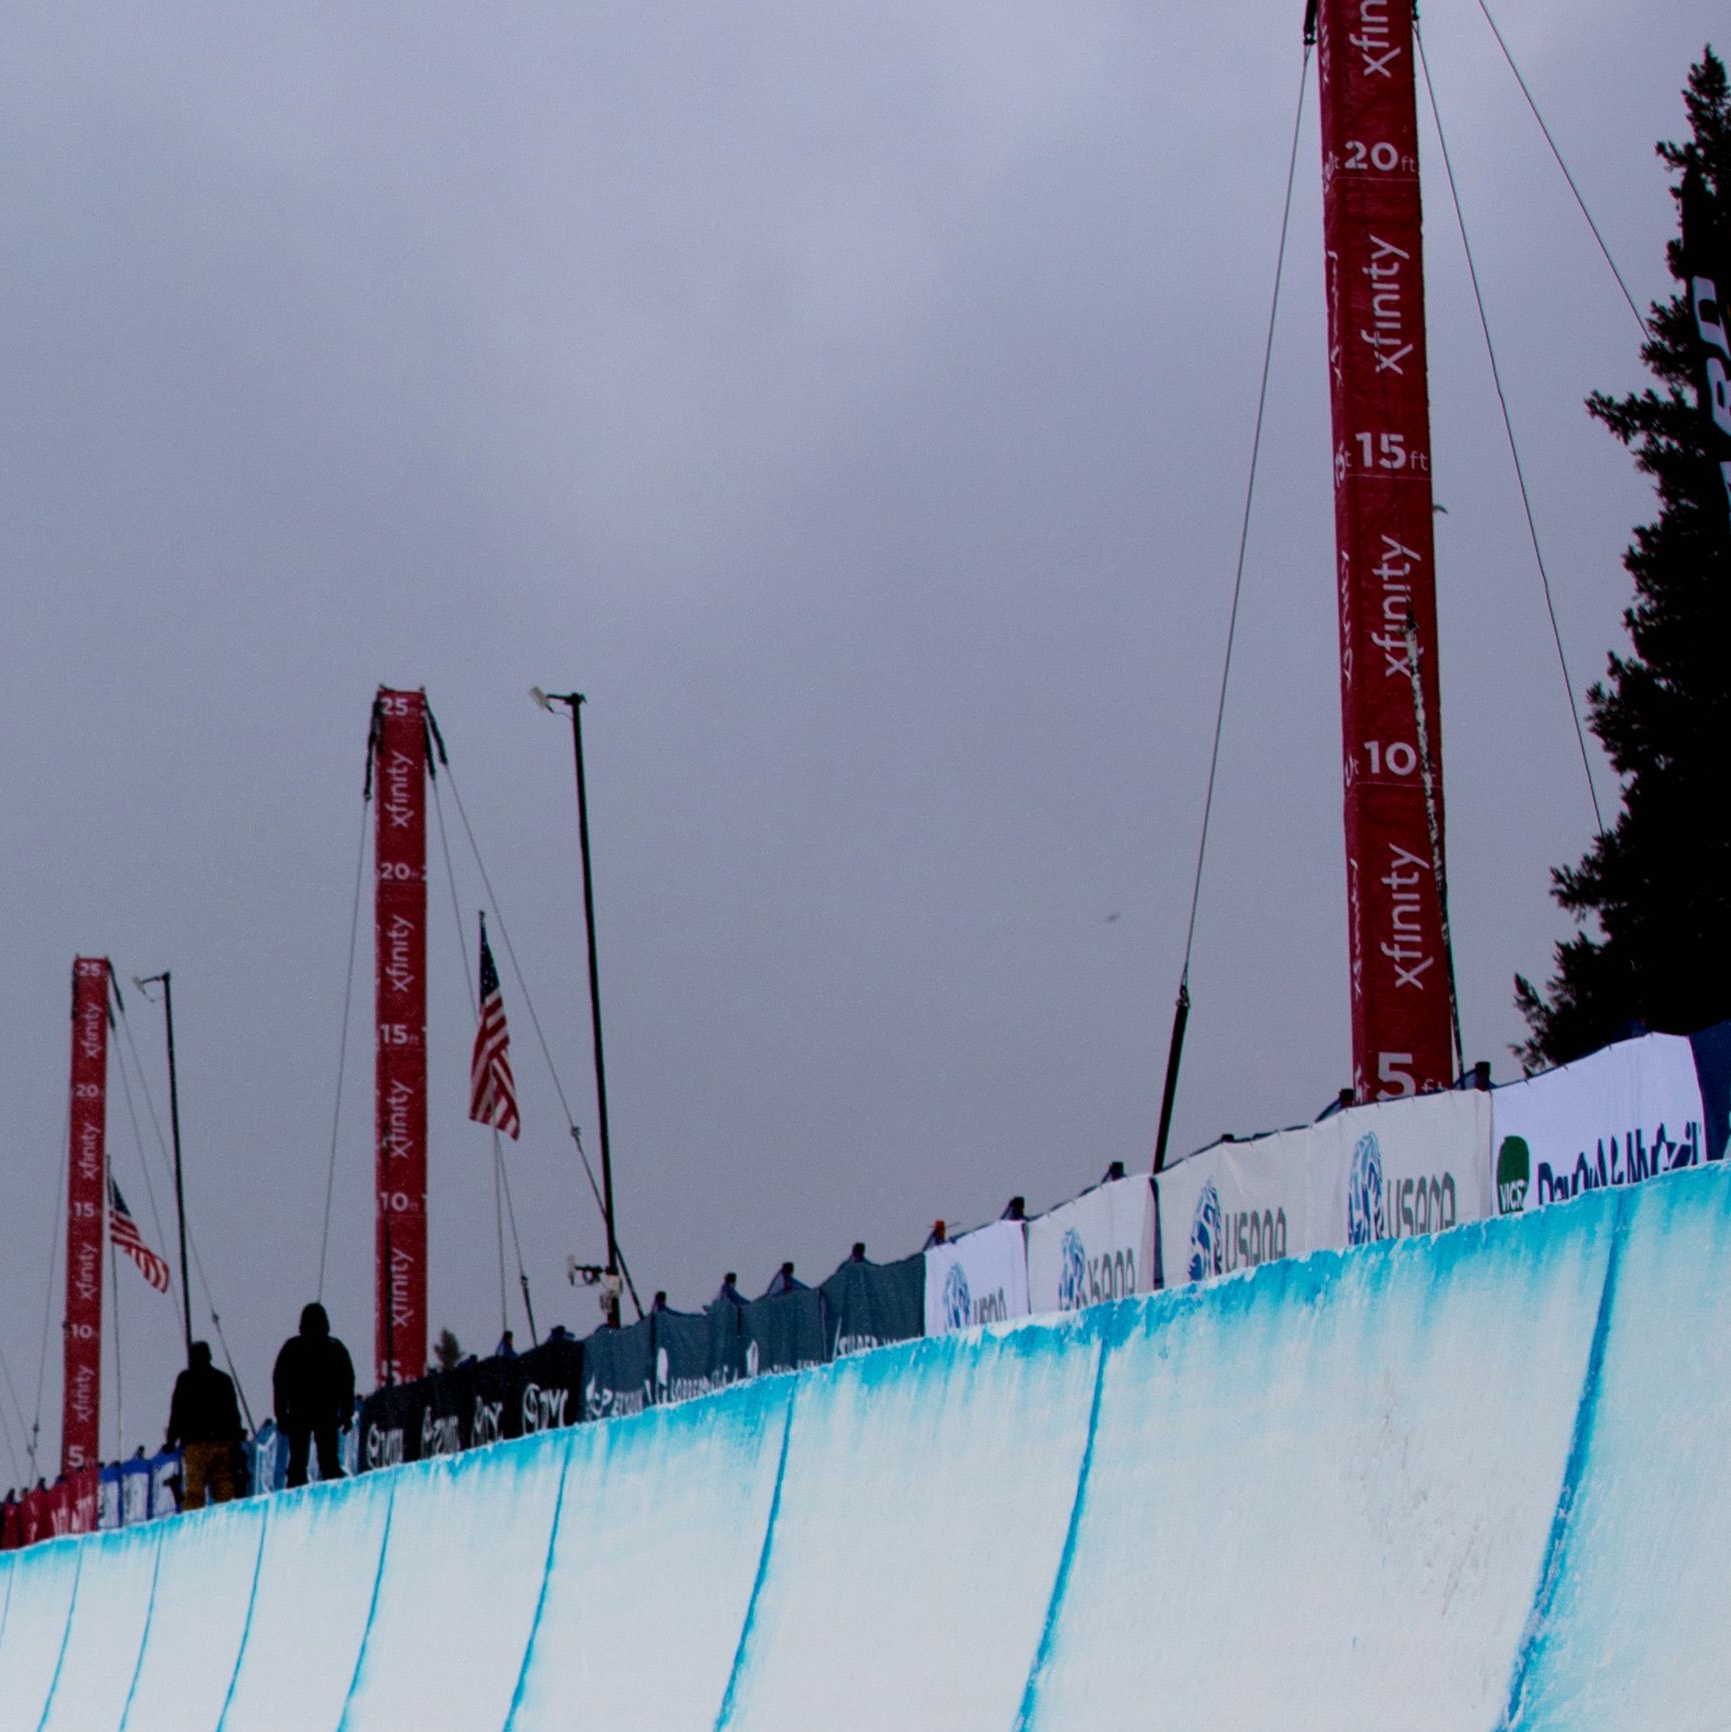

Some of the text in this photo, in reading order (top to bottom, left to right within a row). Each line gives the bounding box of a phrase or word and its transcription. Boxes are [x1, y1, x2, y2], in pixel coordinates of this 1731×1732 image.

[1344, 141, 1399, 171] 20
[1360, 234, 1414, 375] xfinity
[1355, 432, 1429, 471] 15 ft
[1371, 534, 1424, 678] xfinity
[381, 698, 408, 716] 25
[1363, 740, 1417, 776] 10
[384, 751, 414, 828] xfinity
[380, 863, 410, 880] 20
[1380, 842, 1434, 991] xfinity
[386, 915, 415, 992] xfinity
[81, 1002, 103, 1059] xfinity
[380, 1025, 408, 1045] 15
[76, 1084, 99, 1097] 20
[1376, 1051, 1417, 1101] 5
[383, 1080, 414, 1159] xfinity
[78, 1122, 101, 1180] xfinity
[74, 1202, 94, 1217] 15
[380, 1192, 409, 1212] 10
[76, 1242, 97, 1301] xfinity
[71, 1324, 93, 1338] 10
[72, 1364, 94, 1423] xfinity
[68, 1445, 84, 1469] 5
